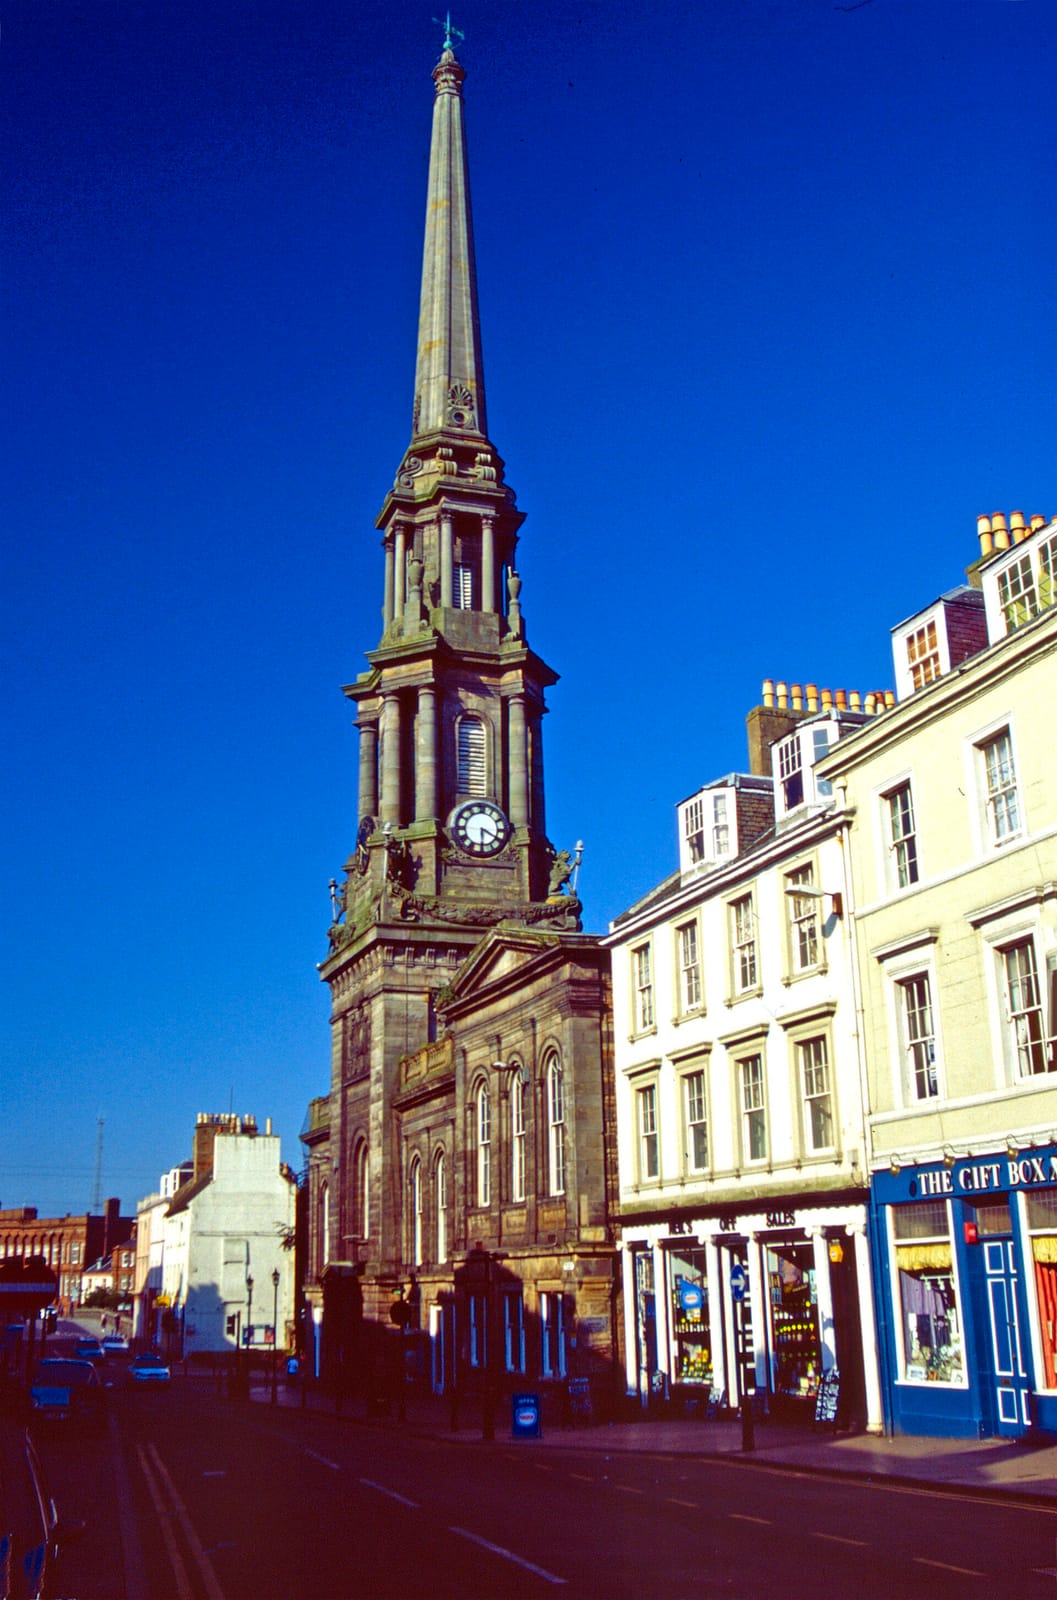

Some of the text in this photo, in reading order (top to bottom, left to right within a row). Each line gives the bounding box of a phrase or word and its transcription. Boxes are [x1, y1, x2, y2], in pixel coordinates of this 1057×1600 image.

[917, 1170, 954, 1195] THE
[958, 1164, 1001, 1190] GIFT
[1007, 1158, 1046, 1185] BOX
[719, 1214, 737, 1231] OFF
[766, 1208, 796, 1228] SALES
